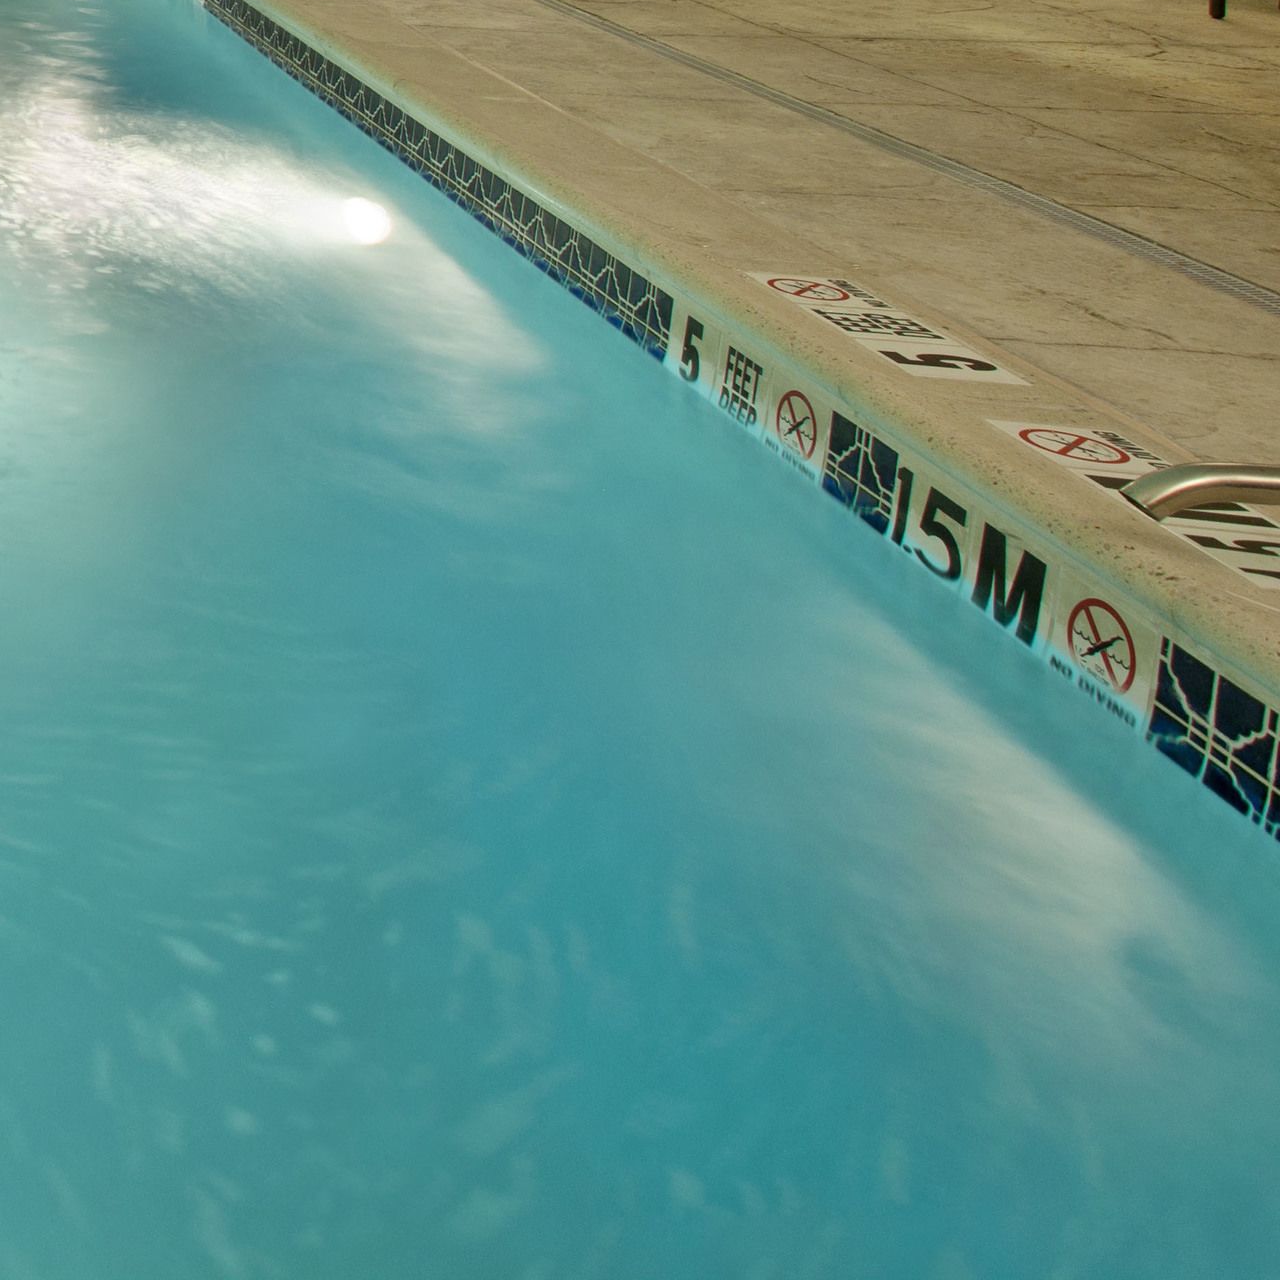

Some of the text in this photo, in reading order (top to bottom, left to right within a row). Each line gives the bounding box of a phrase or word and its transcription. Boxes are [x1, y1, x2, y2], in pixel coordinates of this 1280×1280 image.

[811, 308, 894, 335] FEET
[679, 315, 763, 405] 5 FEET
[877, 350, 997, 372] 5
[718, 385, 757, 427] DEEP
[891, 466, 967, 582] 1.5
[971, 521, 1047, 648] M
[1050, 654, 1073, 679] NO
[1078, 675, 1137, 727] DIVING
